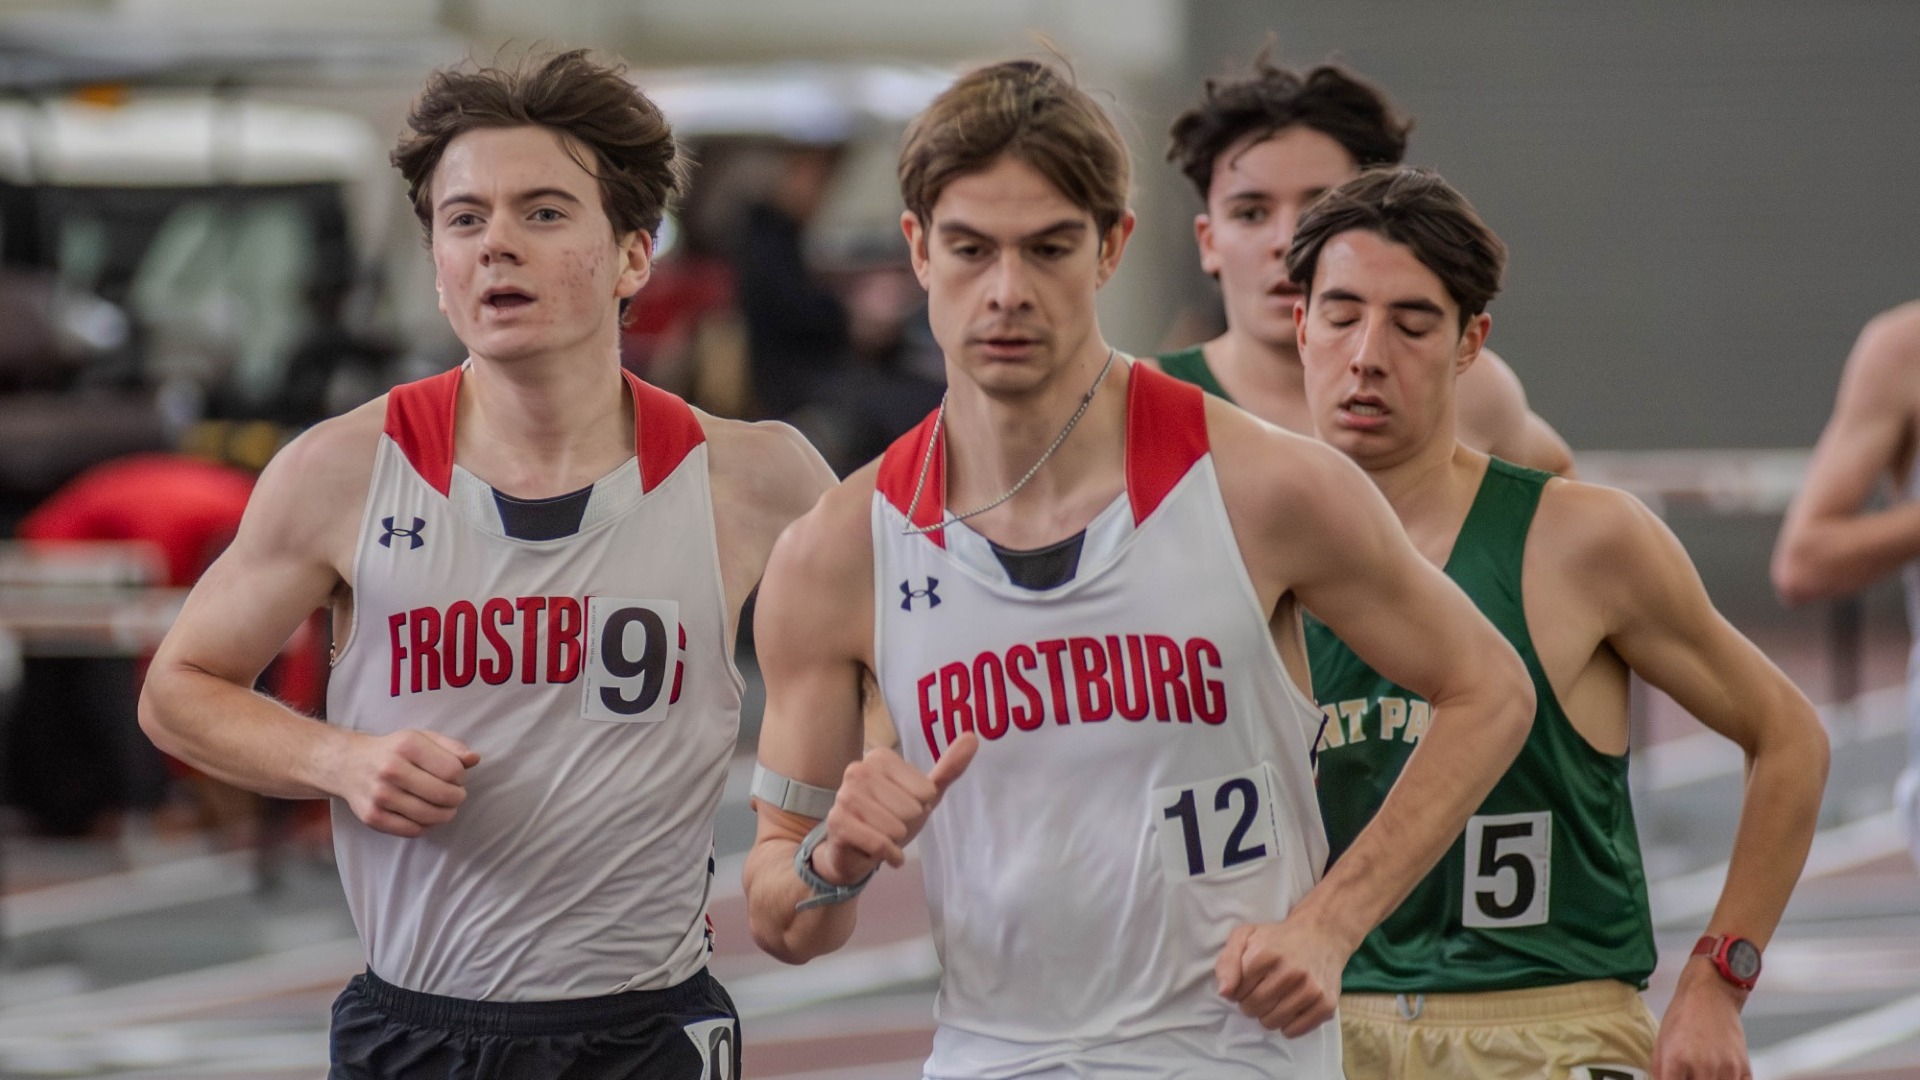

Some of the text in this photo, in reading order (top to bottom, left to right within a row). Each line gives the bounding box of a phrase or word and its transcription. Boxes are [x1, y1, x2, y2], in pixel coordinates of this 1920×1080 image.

[388, 596, 686, 706] FROSTB
[600, 607, 667, 715] 9
[917, 634, 1228, 763] FROSTBURG
[1164, 777, 1267, 876] 12
[1475, 822, 1536, 919] 5
